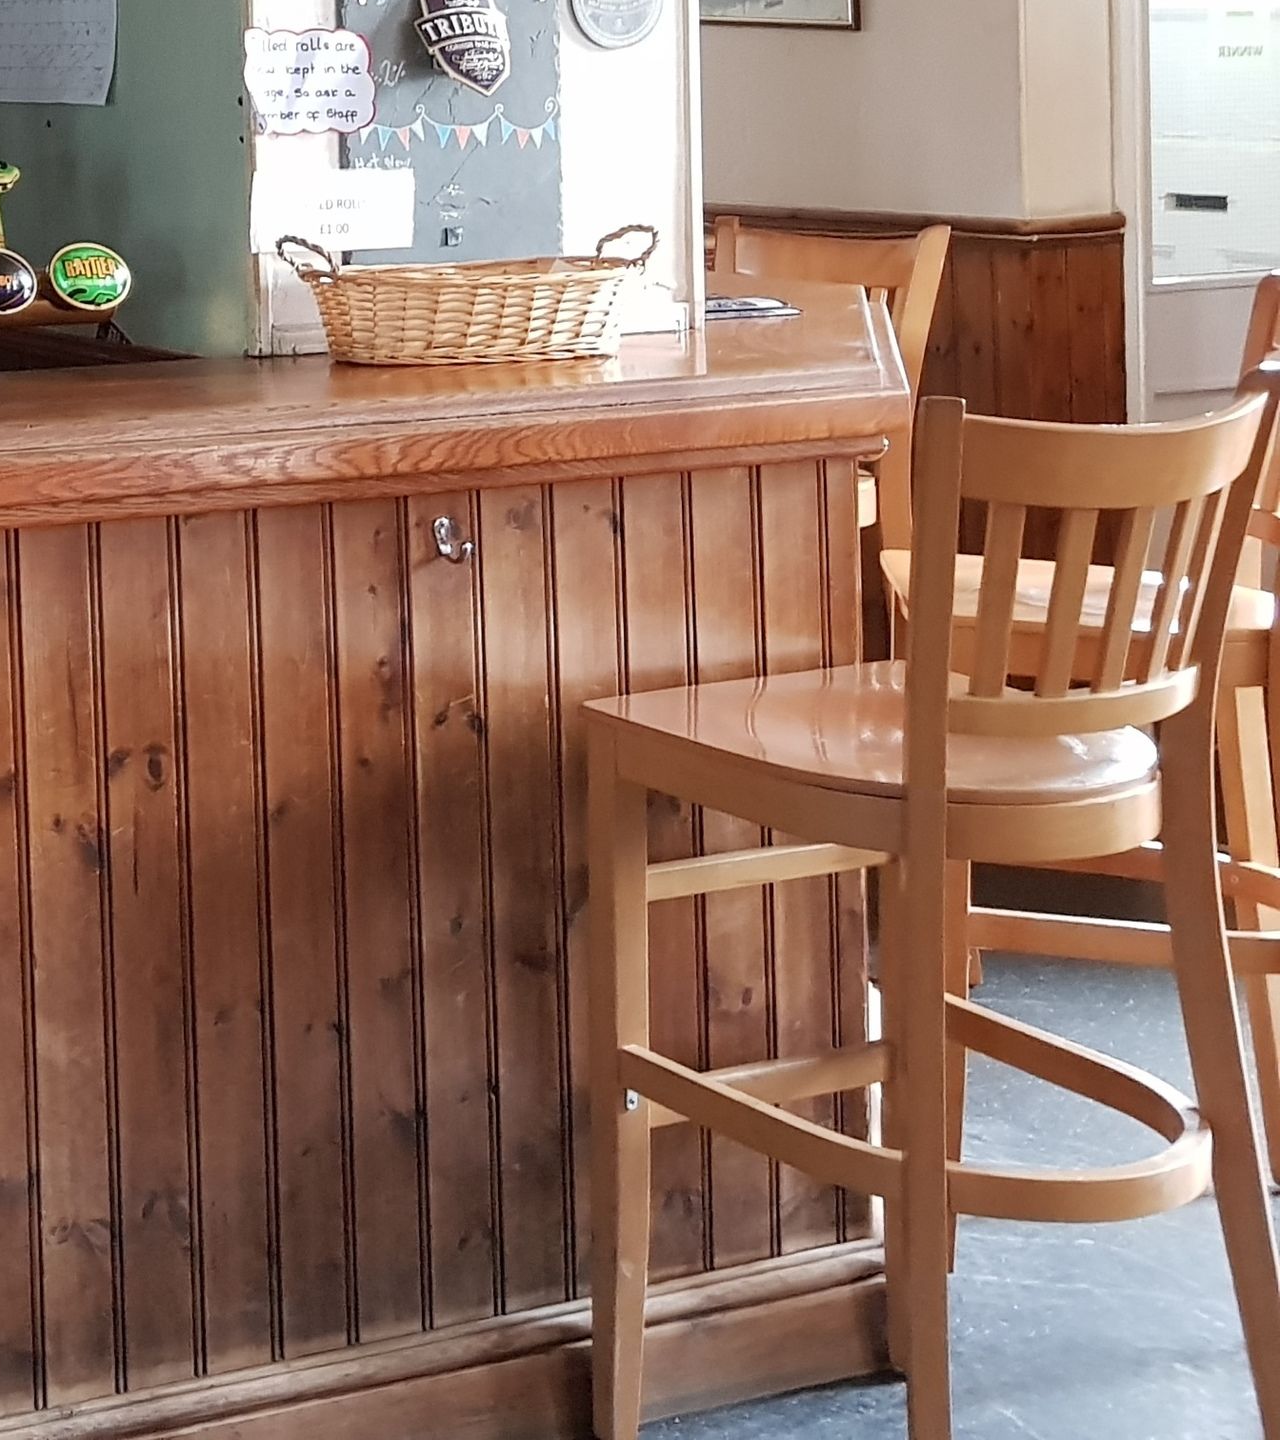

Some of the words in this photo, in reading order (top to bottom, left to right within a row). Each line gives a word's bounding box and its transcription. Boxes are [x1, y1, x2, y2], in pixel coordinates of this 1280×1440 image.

[421, 13, 500, 42] TRIBUT
[296, 37, 330, 52] rolls
[335, 42, 356, 52] are
[324, 65, 336, 74] in
[341, 63, 361, 75] the
[315, 89, 339, 98] ask
[344, 89, 356, 98] a
[306, 110, 320, 121] of
[64, 256, 116, 279] RATTLER
